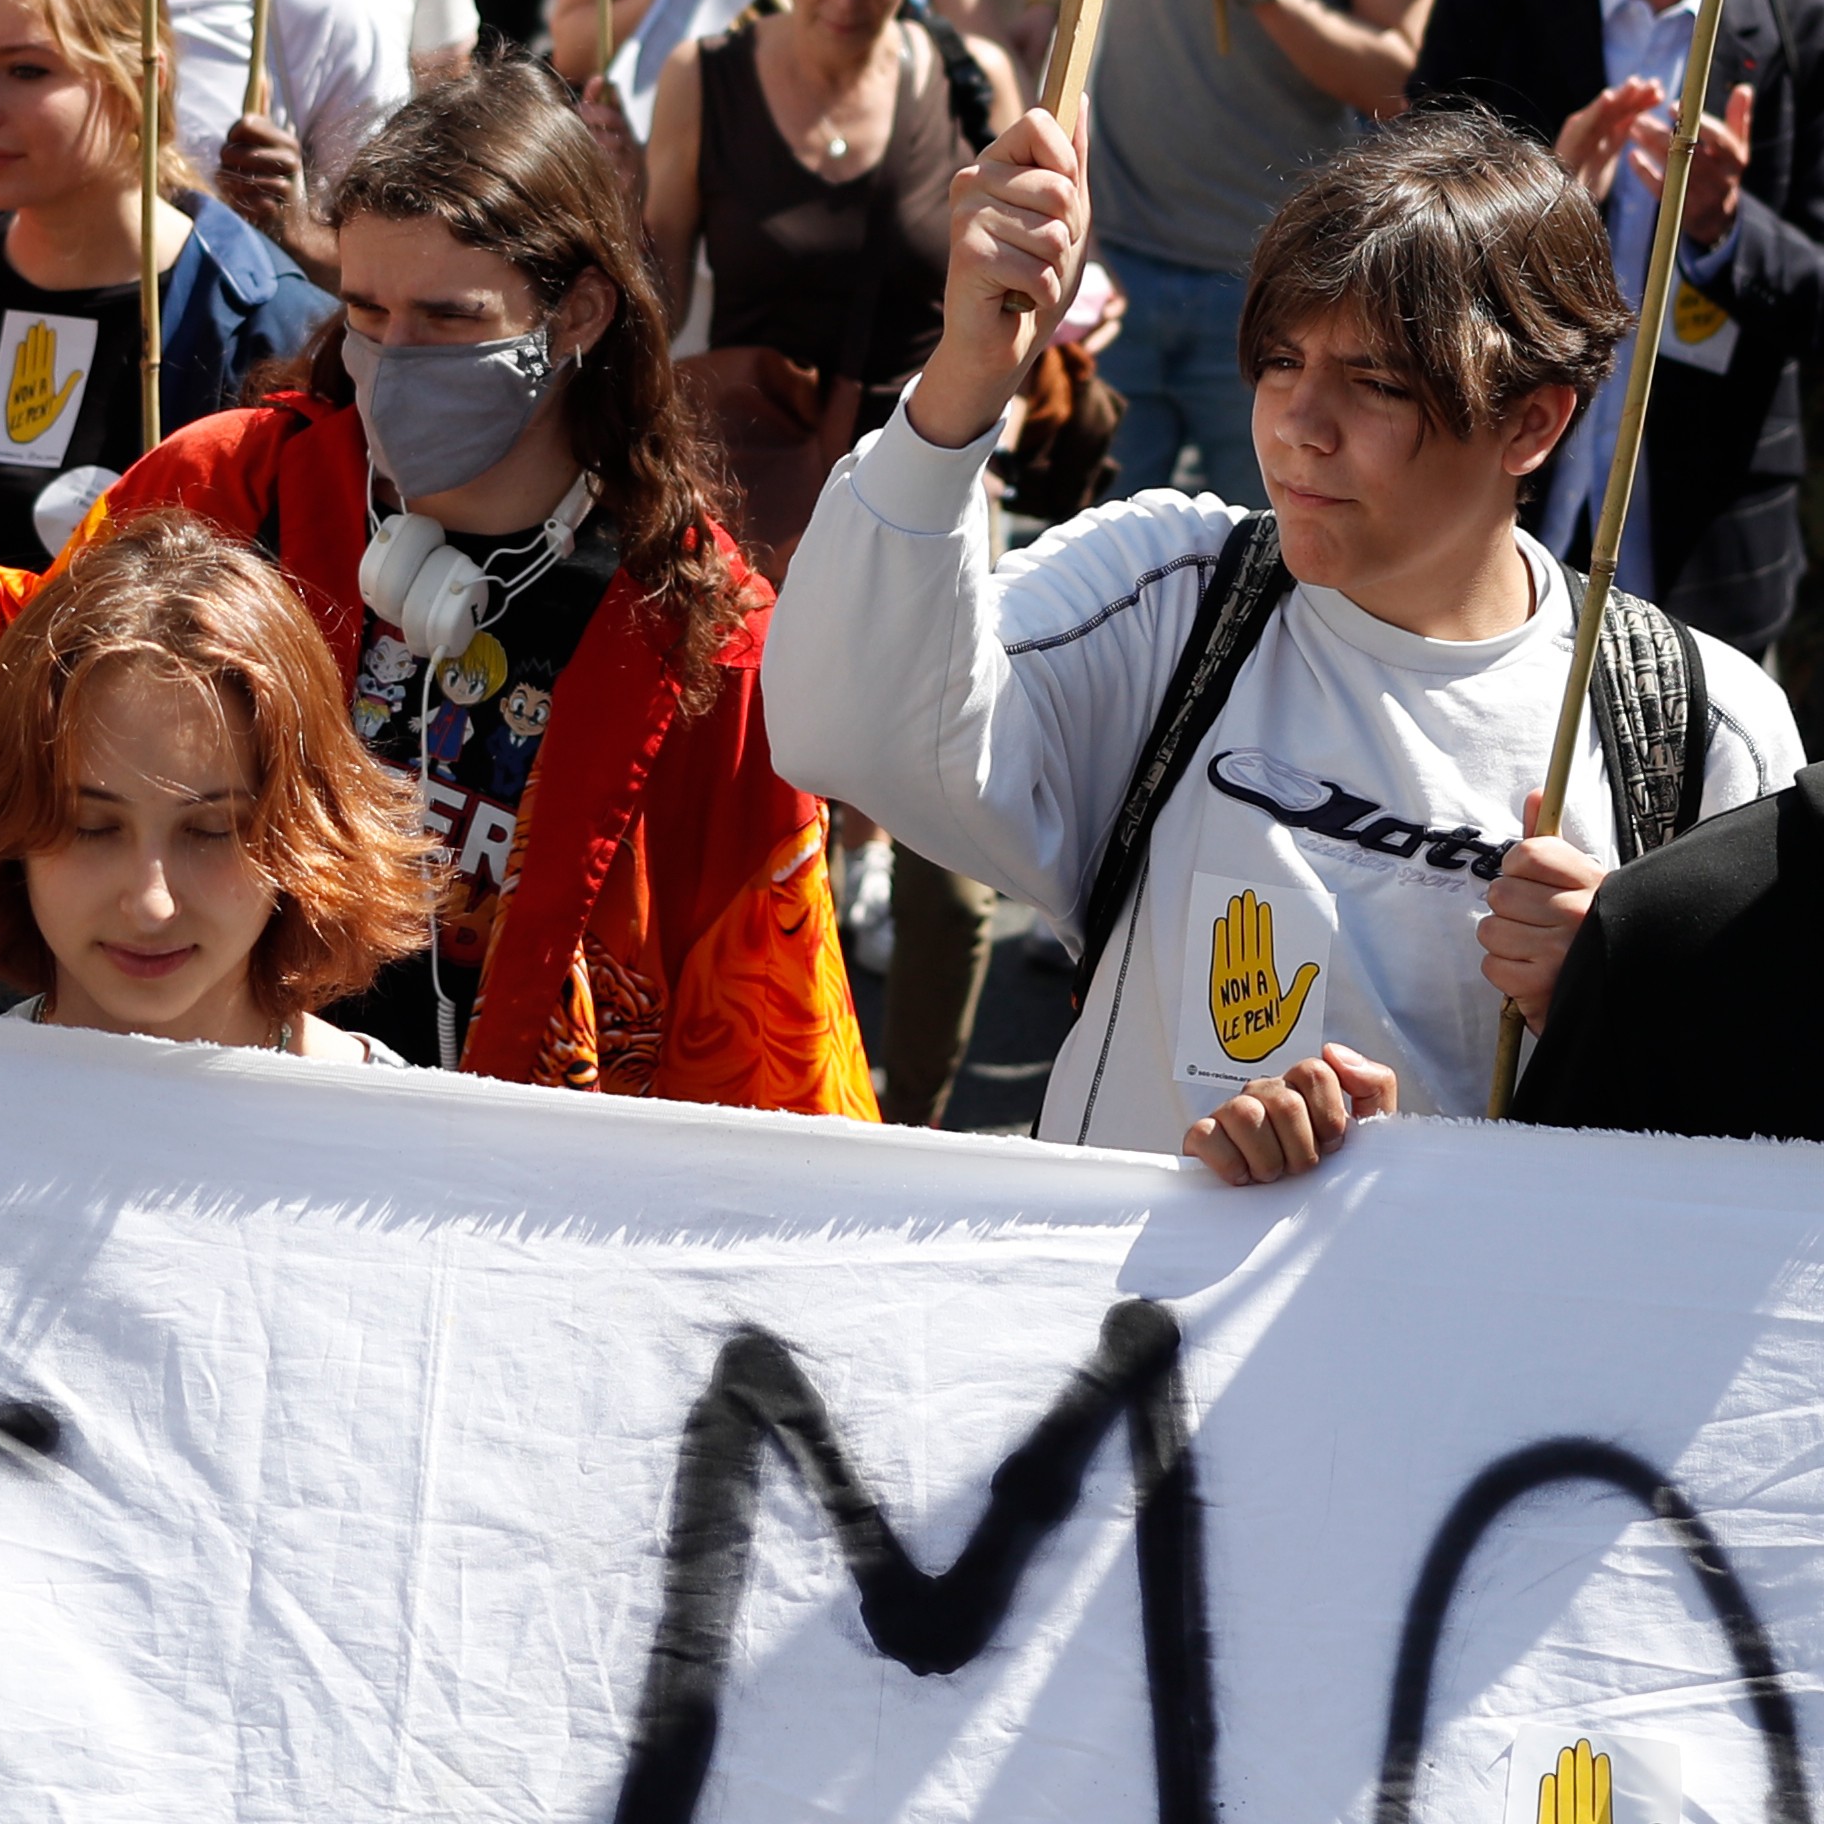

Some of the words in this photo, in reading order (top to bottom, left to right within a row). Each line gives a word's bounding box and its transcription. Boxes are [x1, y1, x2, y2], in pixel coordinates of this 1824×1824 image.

[1220, 971, 1250, 1008] NON
[1257, 969, 1268, 996] A
[1223, 1016, 1241, 1043] LE
[1244, 998, 1280, 1035] PEN!
